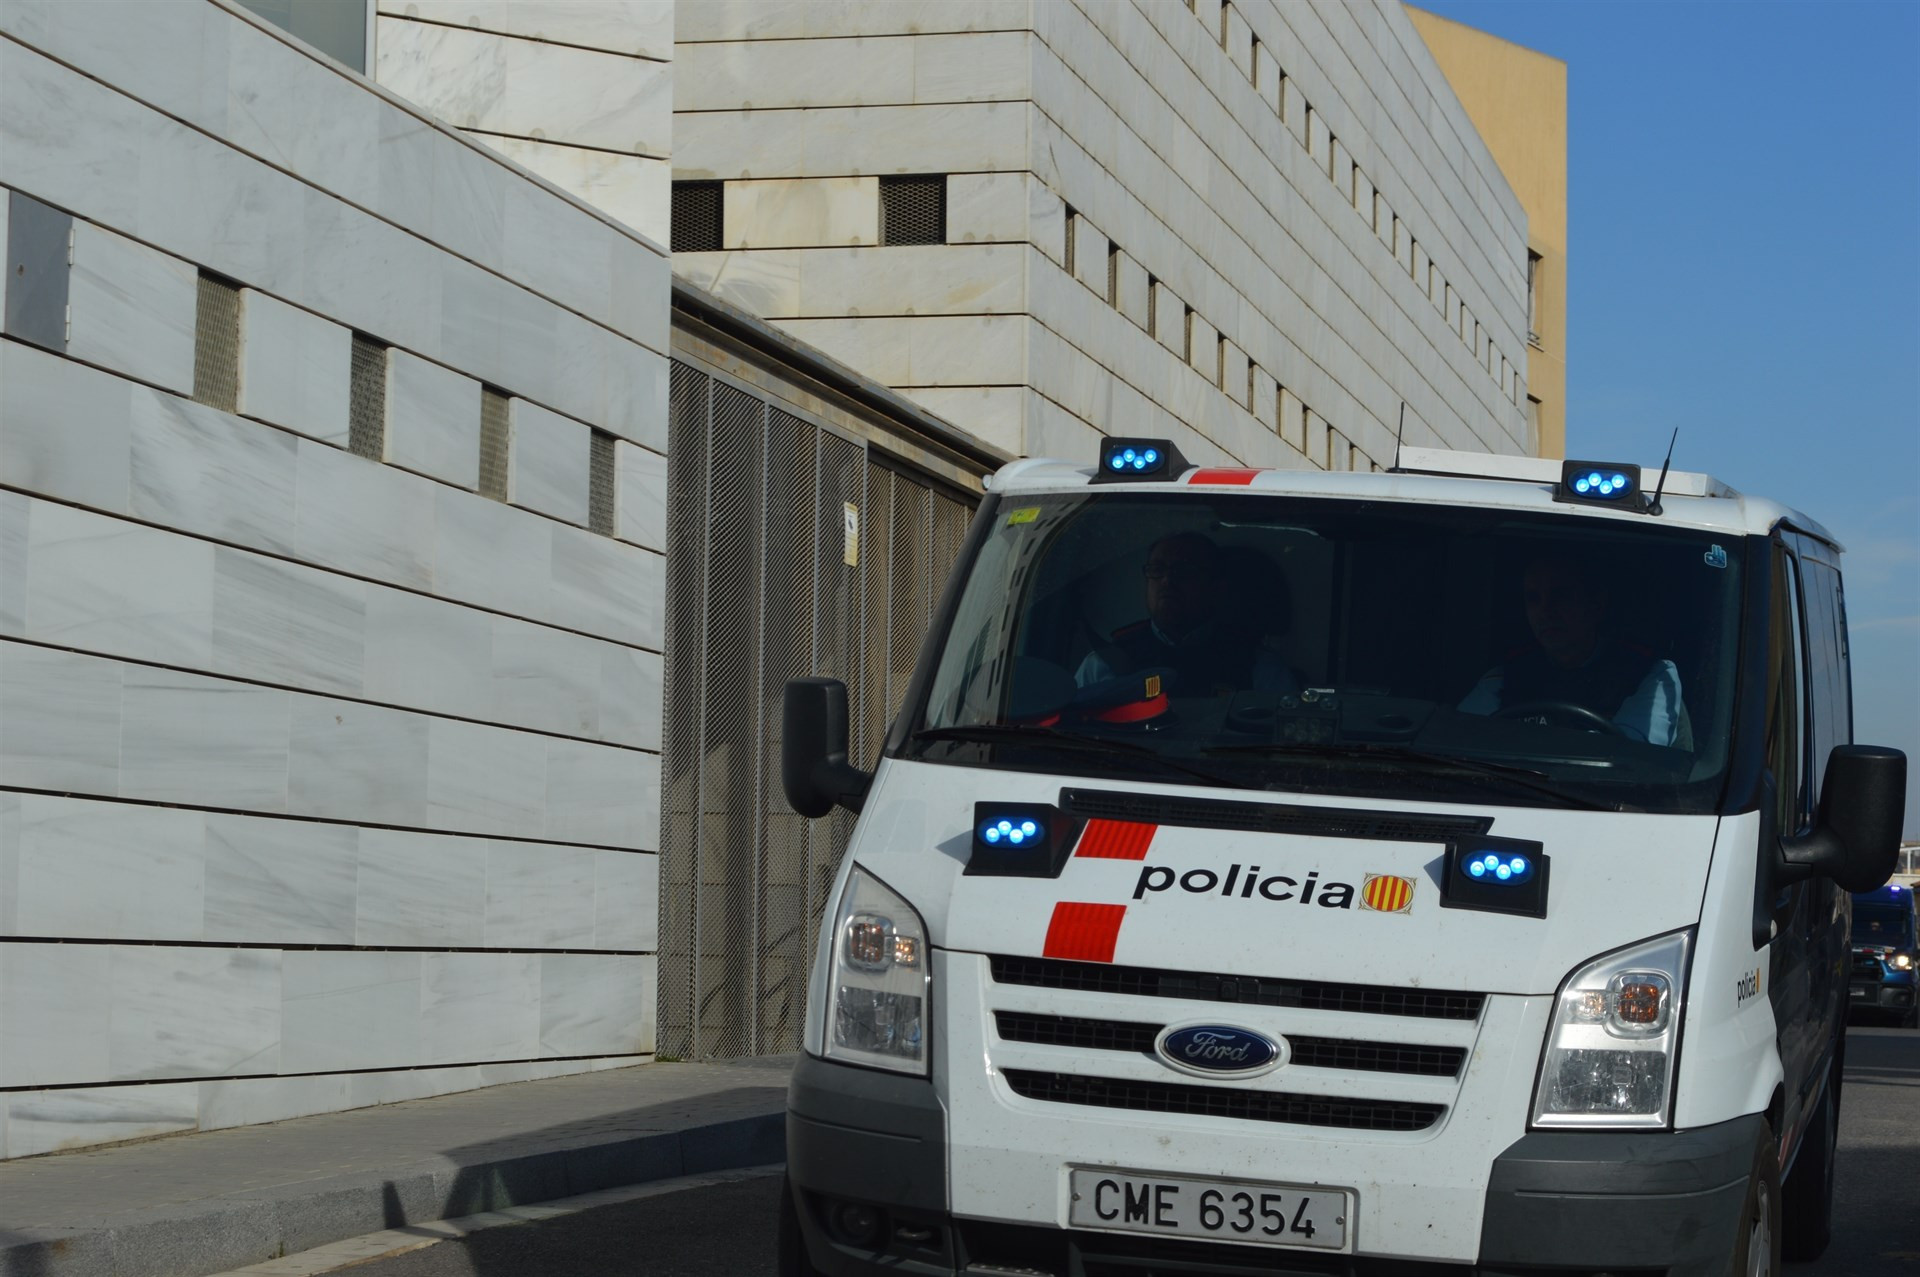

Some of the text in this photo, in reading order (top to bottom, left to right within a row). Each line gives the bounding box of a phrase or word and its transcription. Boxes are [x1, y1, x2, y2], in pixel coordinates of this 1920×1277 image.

[1132, 863, 1355, 910] policia
[1737, 969, 1756, 1009] policia
[1184, 1031, 1251, 1062] Ford
[1094, 1179, 1316, 1239] CME 6354
